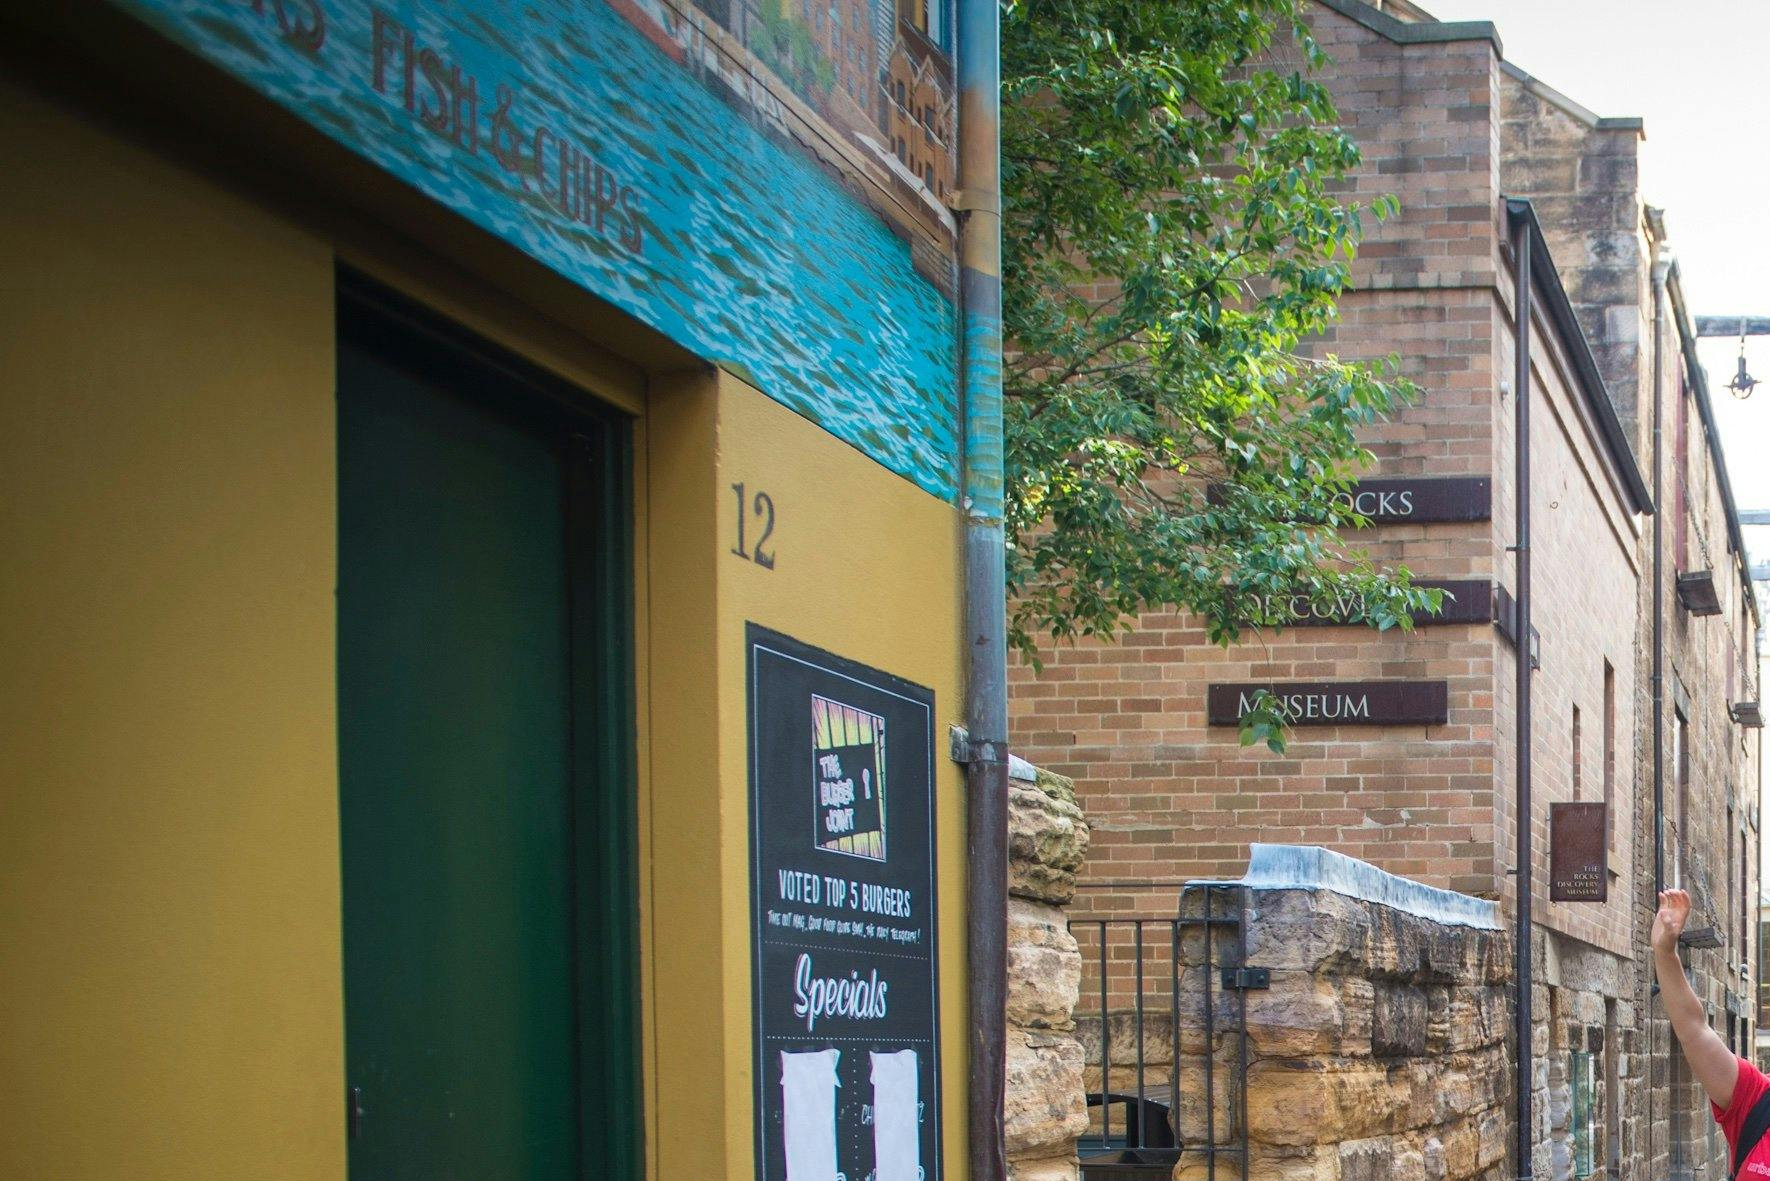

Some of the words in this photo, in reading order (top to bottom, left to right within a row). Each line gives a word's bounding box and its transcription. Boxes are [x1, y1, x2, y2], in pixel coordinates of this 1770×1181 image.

[371, 9, 478, 157] FISH
[492, 84, 530, 191] &
[534, 126, 643, 255] CHIPS
[730, 482, 776, 571] 12
[1330, 490, 1413, 516] OCKS
[819, 754, 842, 779] THE
[825, 808, 854, 833] JOINT
[778, 869, 820, 904] VOTED
[824, 876, 846, 908] TOP
[850, 880, 859, 910] 5
[862, 883, 911, 918] BURGERS
[794, 953, 888, 1032] Specials
